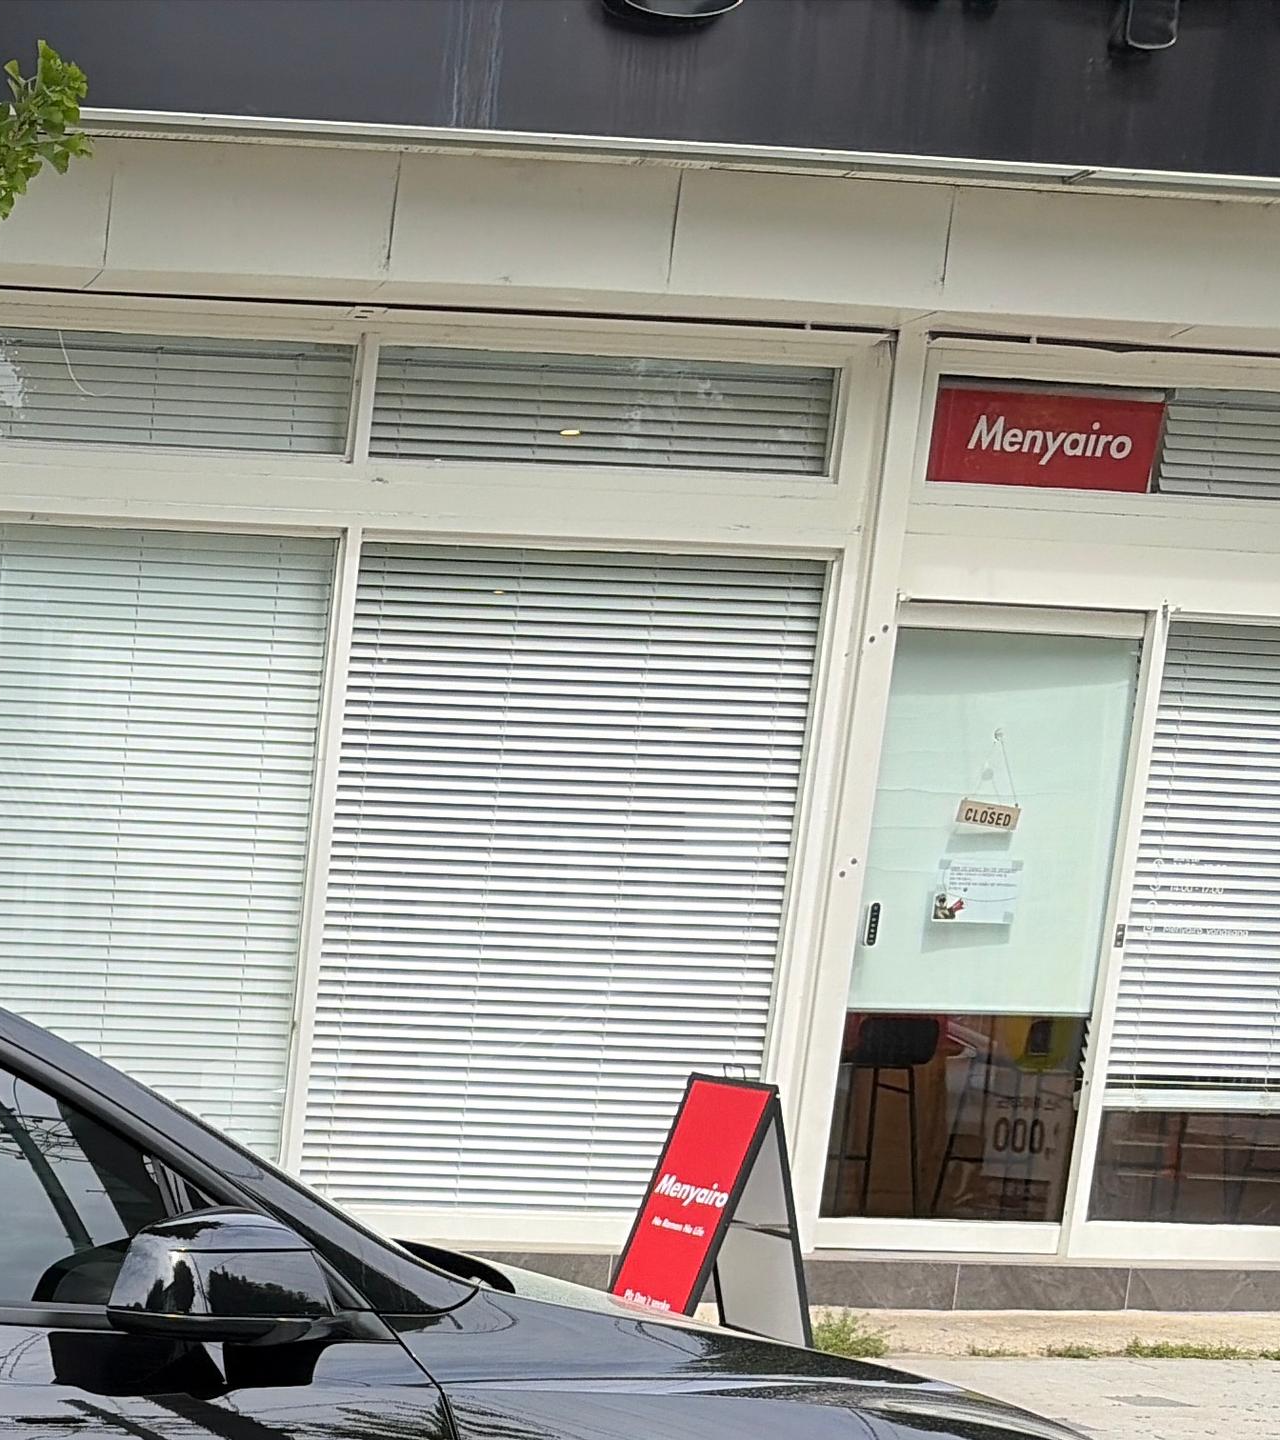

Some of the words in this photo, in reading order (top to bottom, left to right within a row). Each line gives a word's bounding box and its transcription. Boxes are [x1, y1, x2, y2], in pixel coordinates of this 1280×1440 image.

[966, 414, 1133, 466] Menyairo
[964, 807, 1012, 827] CLOSED
[653, 1172, 730, 1208] Menyairo
